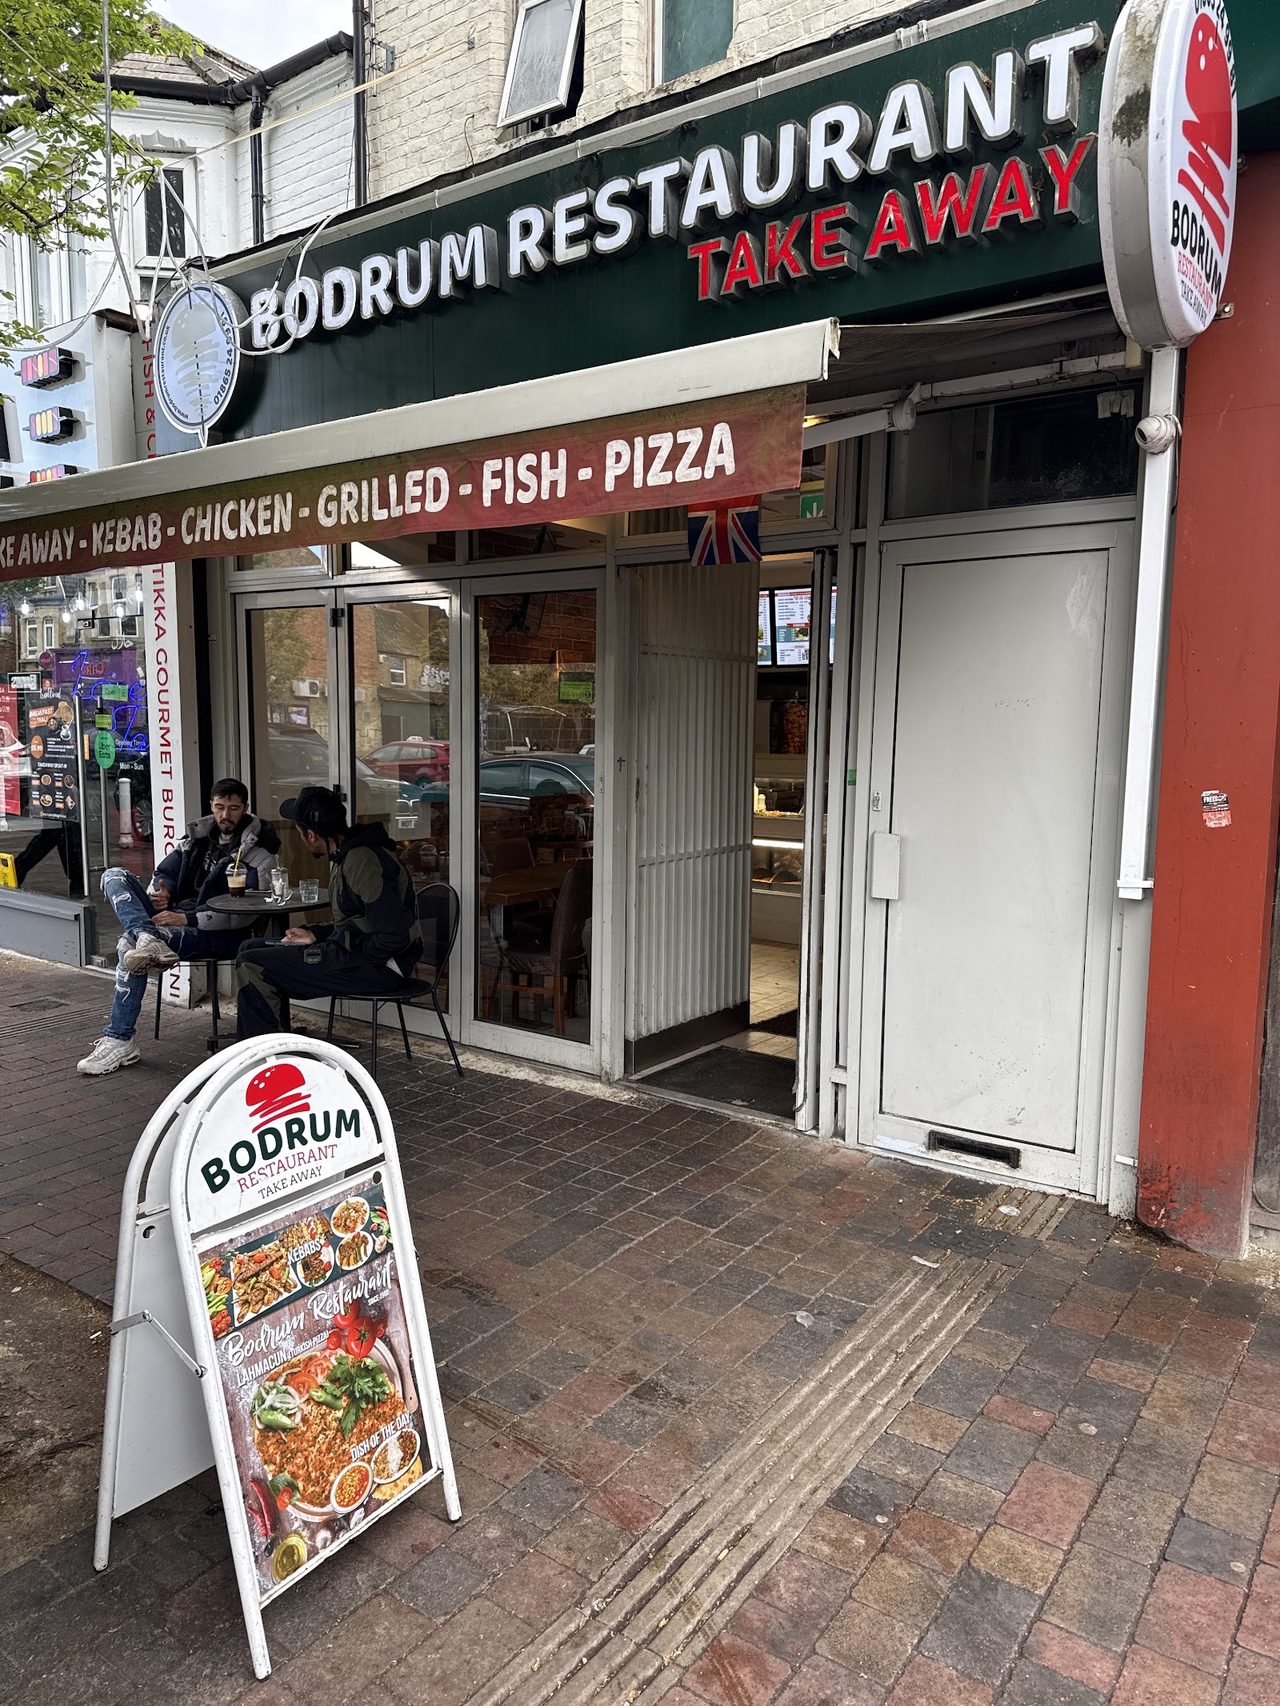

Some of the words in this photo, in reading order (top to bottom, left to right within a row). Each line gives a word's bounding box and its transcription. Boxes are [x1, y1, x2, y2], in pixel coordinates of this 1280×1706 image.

[250, 223, 490, 349] BODRUM
[507, 23, 1098, 279] RESTAURANT
[688, 204, 852, 301] TAKE
[863, 135, 1097, 261] AWAY
[1171, 200, 1222, 302] BODRUM
[1178, 251, 1213, 313] RESTAURANT
[213, 369, 232, 405] 01865
[18, 526, 75, 566] AWAY
[92, 512, 162, 557] KEBAB
[181, 491, 293, 546] CHICKEN
[317, 466, 450, 528] GRILLED
[481, 448, 568, 507] FISH
[604, 421, 737, 492] PIZZA
[152, 563, 167, 641] TIKKA
[156, 647, 173, 780] GOURMET
[119, 761, 130, 770] Mon
[200, 1108, 361, 1194] BODRUM
[237, 1144, 337, 1193] RESTAURANT
[258, 1177, 288, 1200] TAKE
[290, 1165, 323, 1186] AWAY
[287, 1239, 322, 1265] KEBABS
[222, 1311, 305, 1367] Bodrum
[308, 1250, 394, 1320] Restaurant
[236, 1348, 287, 1387] LAHMACUN
[351, 1438, 370, 1462] DISH
[370, 1431, 381, 1448] OF
[381, 1420, 397, 1440] THE
